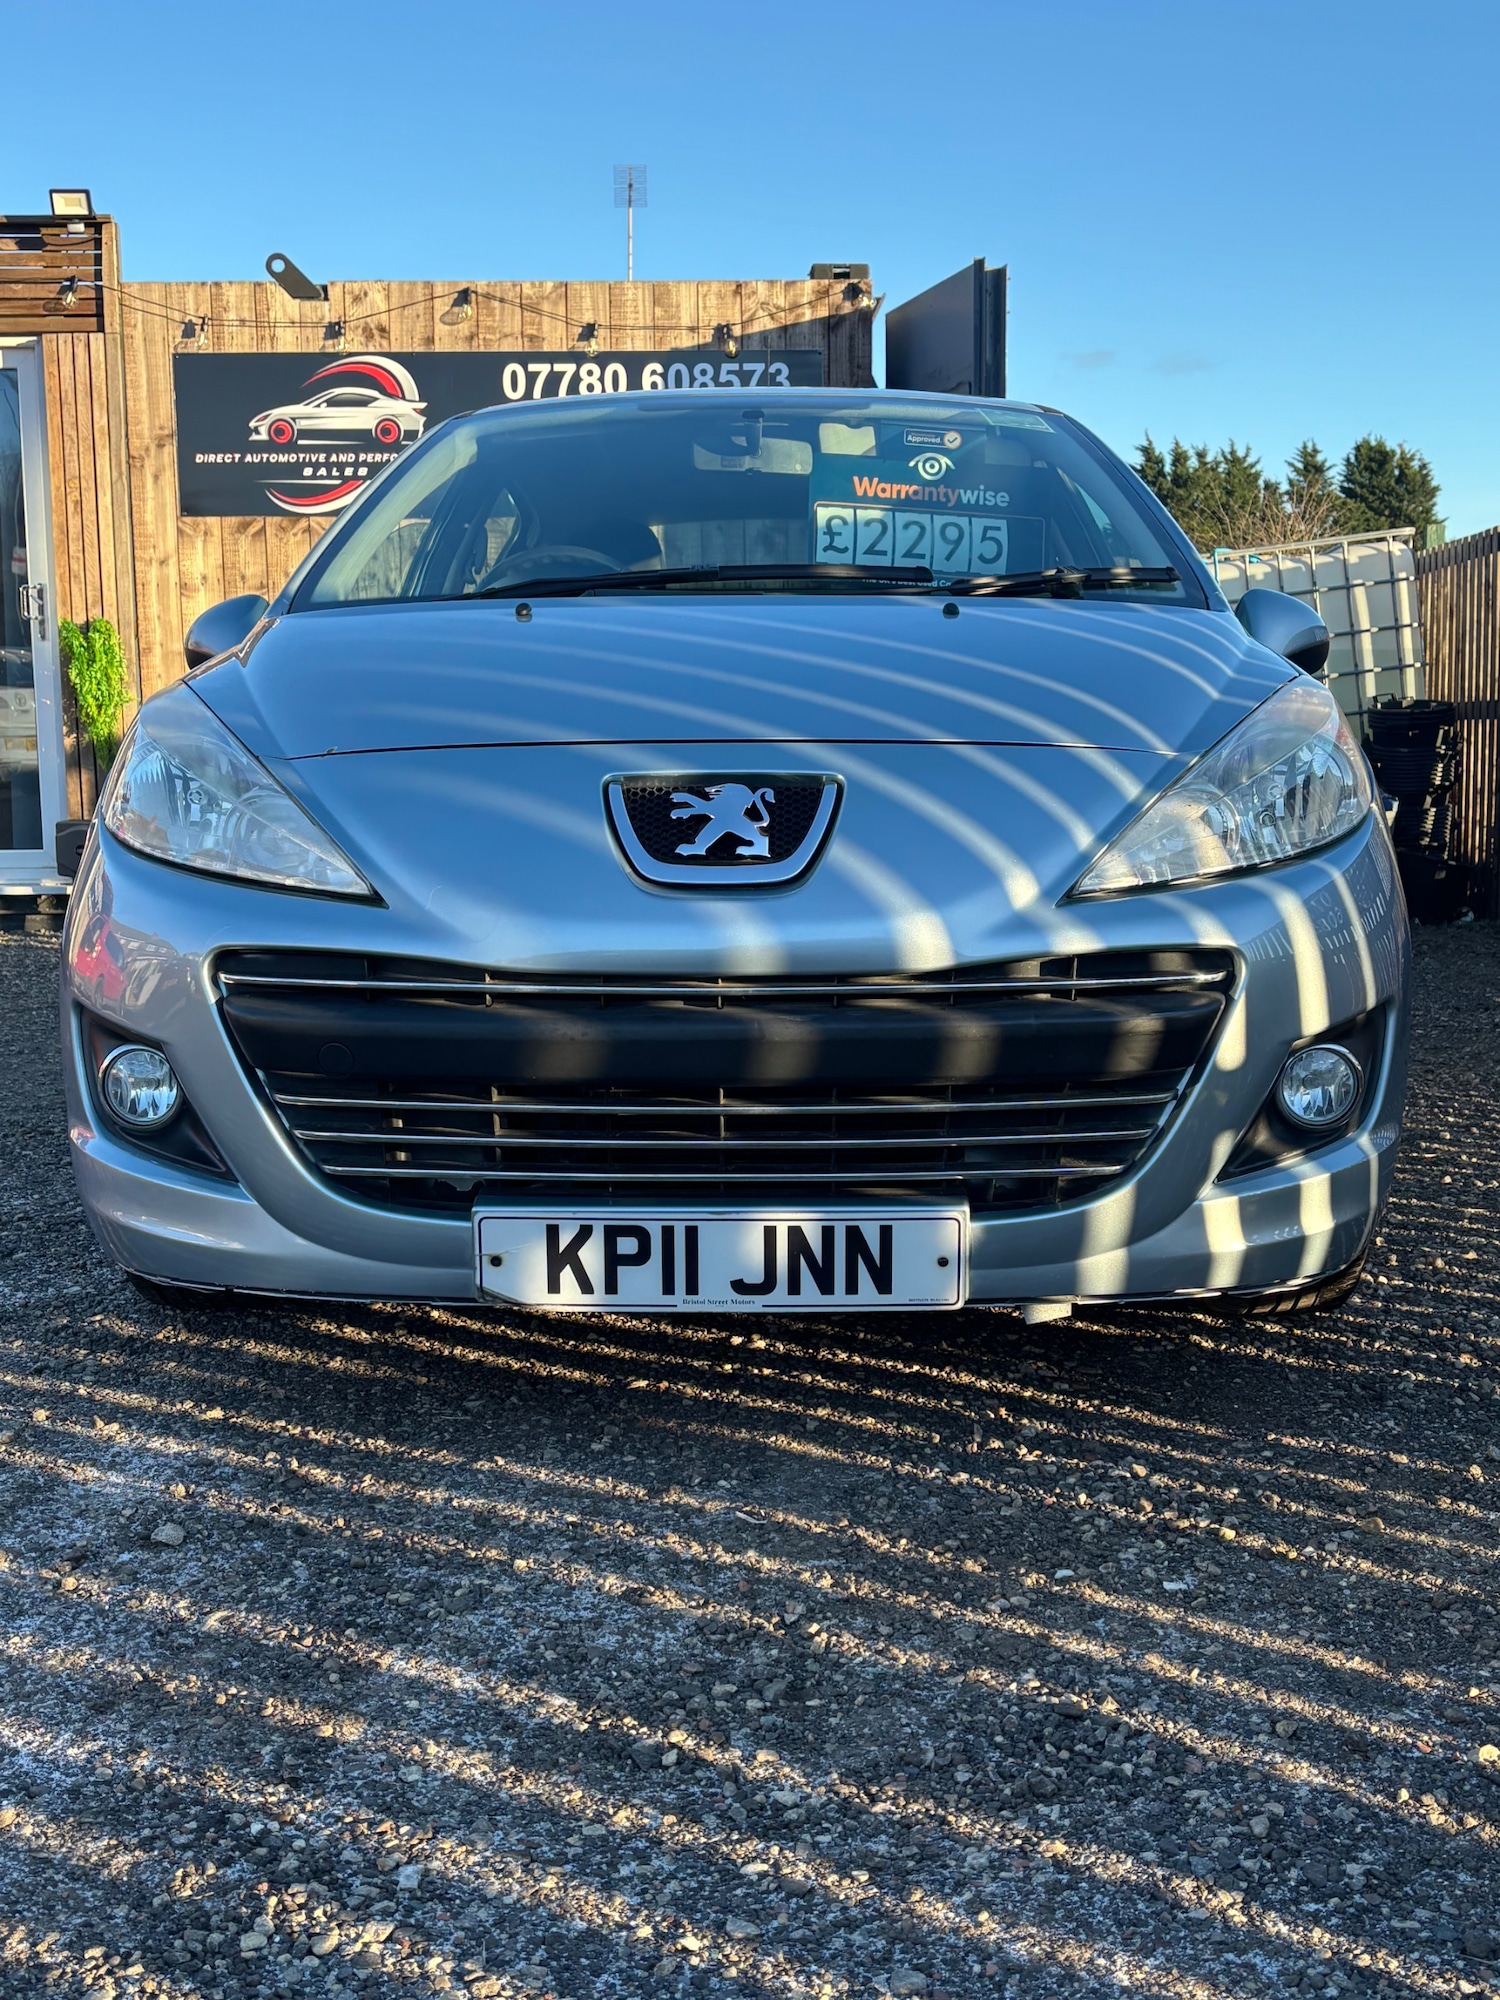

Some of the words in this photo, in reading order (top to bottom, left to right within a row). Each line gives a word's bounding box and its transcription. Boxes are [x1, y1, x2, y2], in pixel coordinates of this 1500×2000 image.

[501, 362, 628, 400] 07780
[641, 362, 792, 391] 608573
[195, 453, 242, 464] DIRECT
[244, 453, 327, 463] AUTOMOTIVE
[329, 453, 356, 463] AND
[302, 467, 369, 477] SALES
[853, 476, 1010, 508] Warrantywise
[822, 514, 1004, 565] £2295
[729, 1224, 894, 1296] JNN
[682, 1298, 706, 1306] Bristol
[707, 1298, 728, 1306] Street
[730, 1298, 756, 1306] Motors
